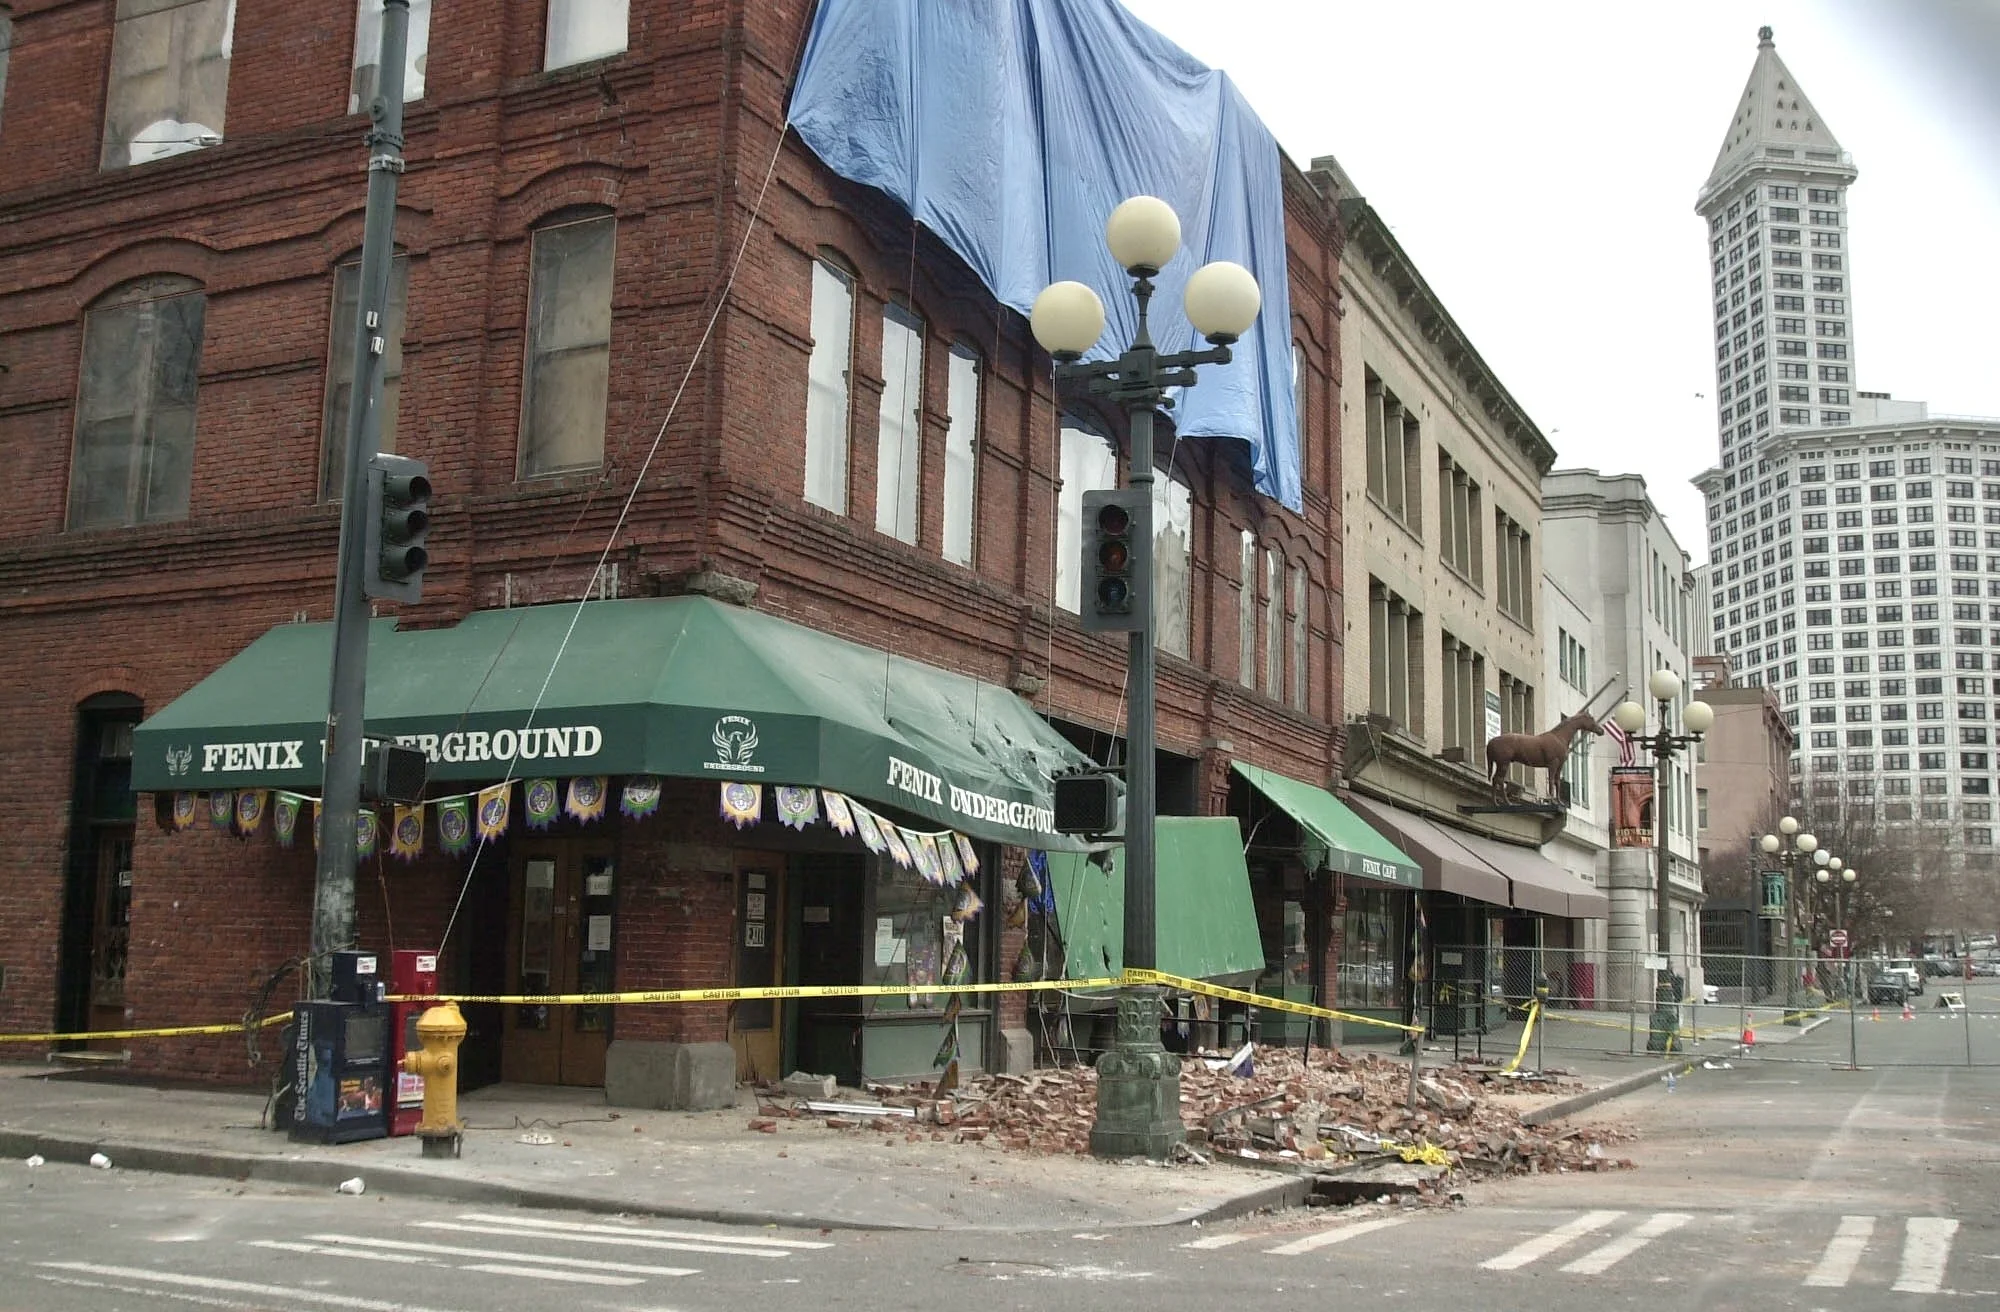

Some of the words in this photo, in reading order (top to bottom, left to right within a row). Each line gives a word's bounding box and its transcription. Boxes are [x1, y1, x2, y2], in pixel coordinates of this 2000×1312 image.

[202, 740, 304, 772] FENIX
[320, 726, 602, 765] RGROUND
[886, 756, 943, 805] FENIX
[949, 784, 1059, 834] UNDERGROU
[642, 991, 681, 1001] CAUTION
[702, 990, 741, 999] CAUTION
[762, 988, 800, 997] CAUTION
[296, 1010, 309, 1051] Times
[295, 1051, 308, 1096] Seattle
